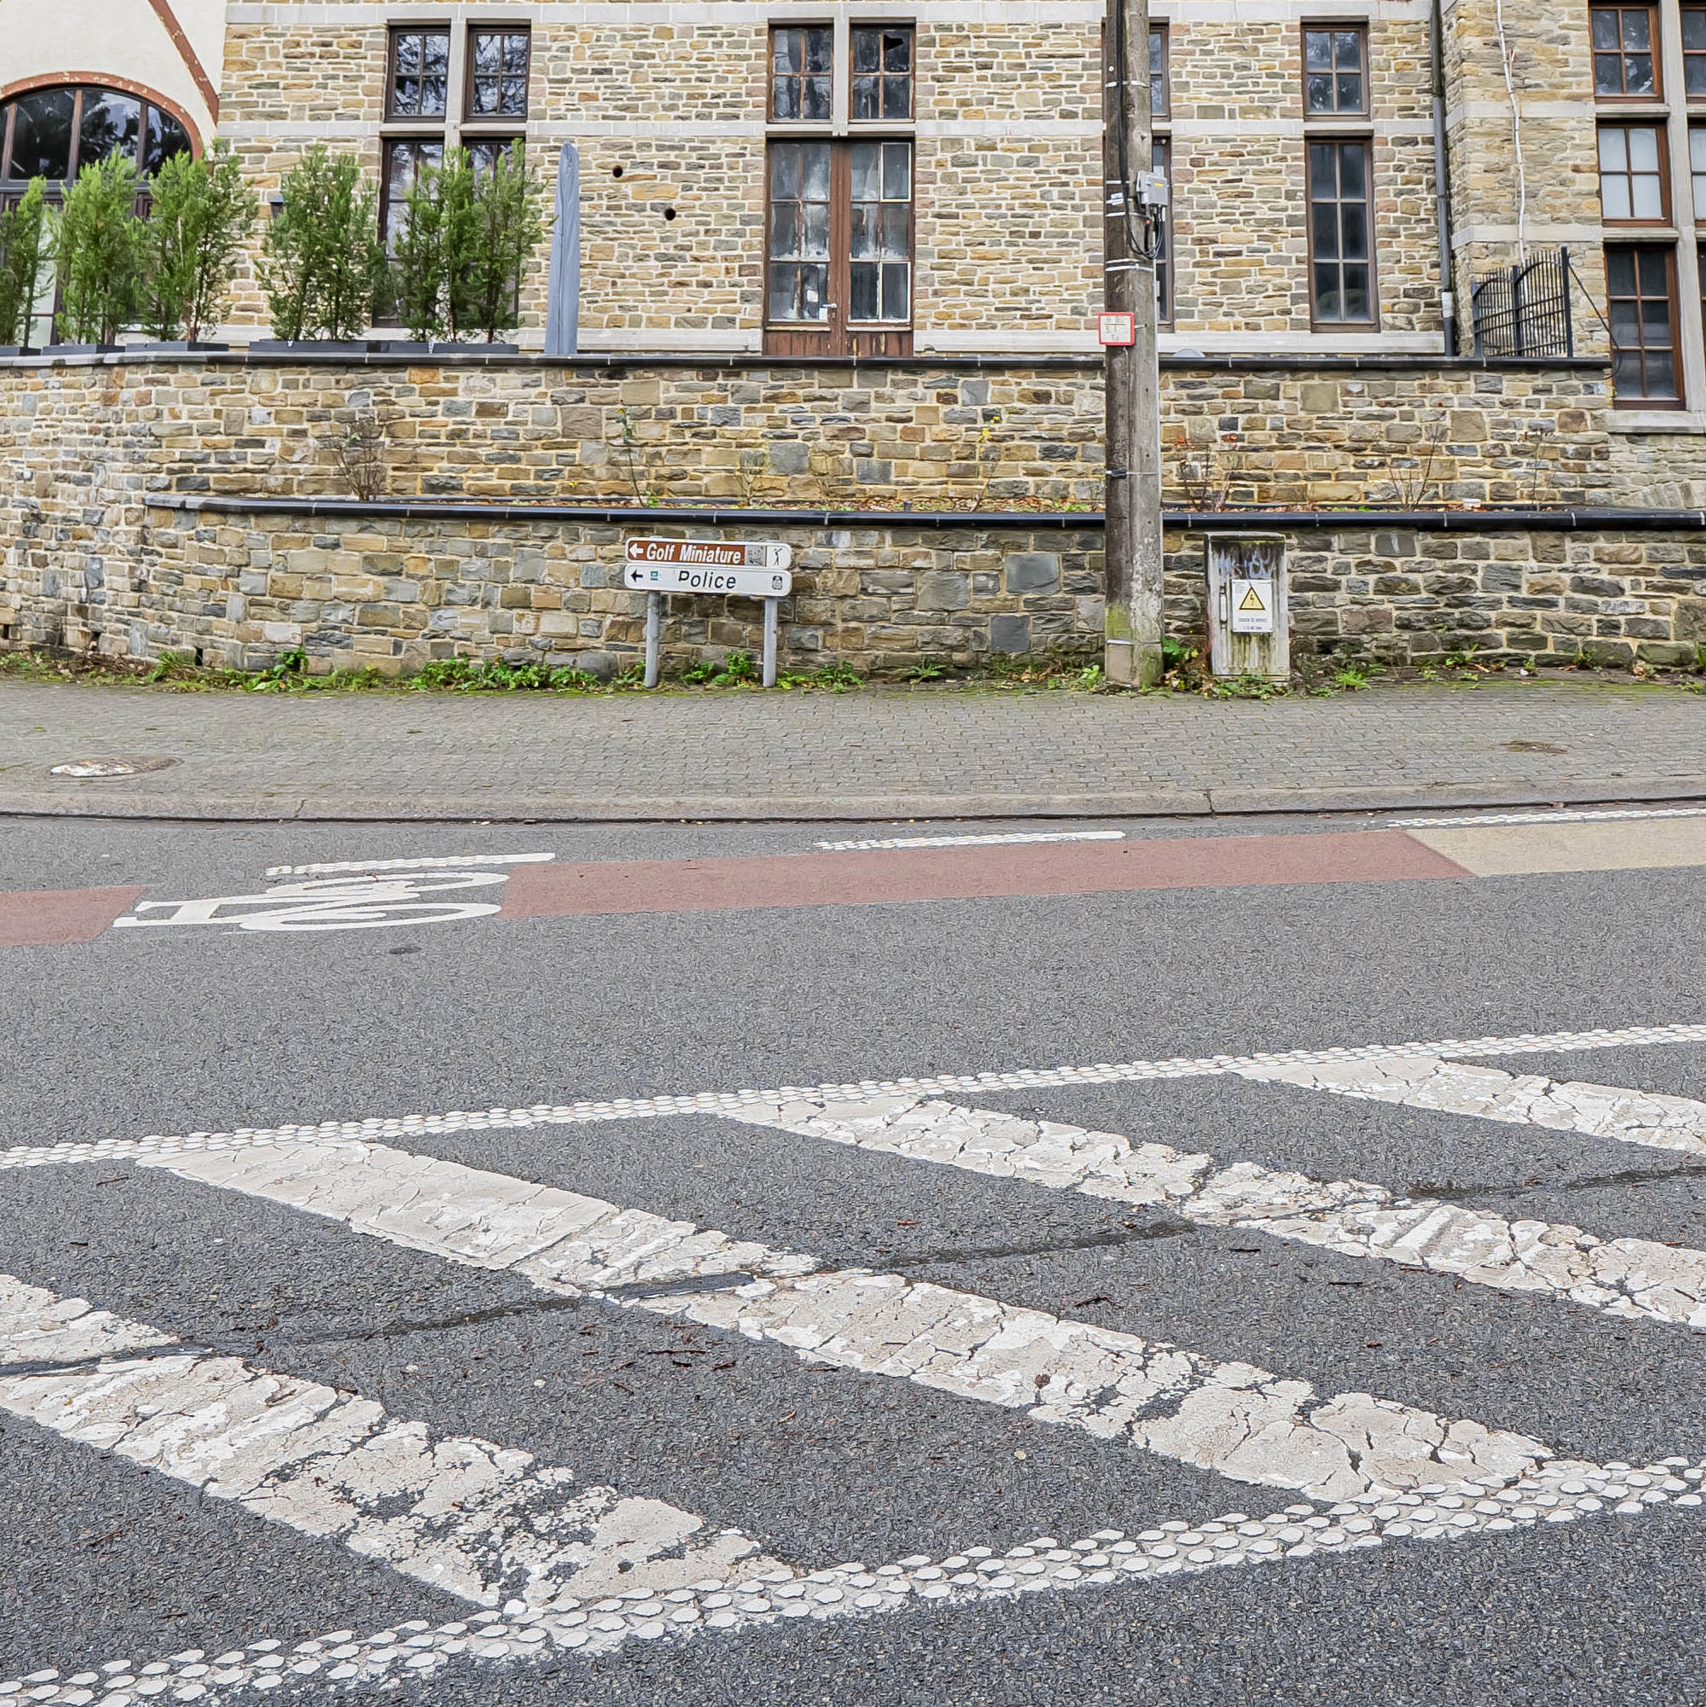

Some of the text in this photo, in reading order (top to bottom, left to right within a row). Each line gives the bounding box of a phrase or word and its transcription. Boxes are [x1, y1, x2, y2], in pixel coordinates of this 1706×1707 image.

[646, 542, 741, 564] Golf Miniature
[678, 570, 736, 589] Police
